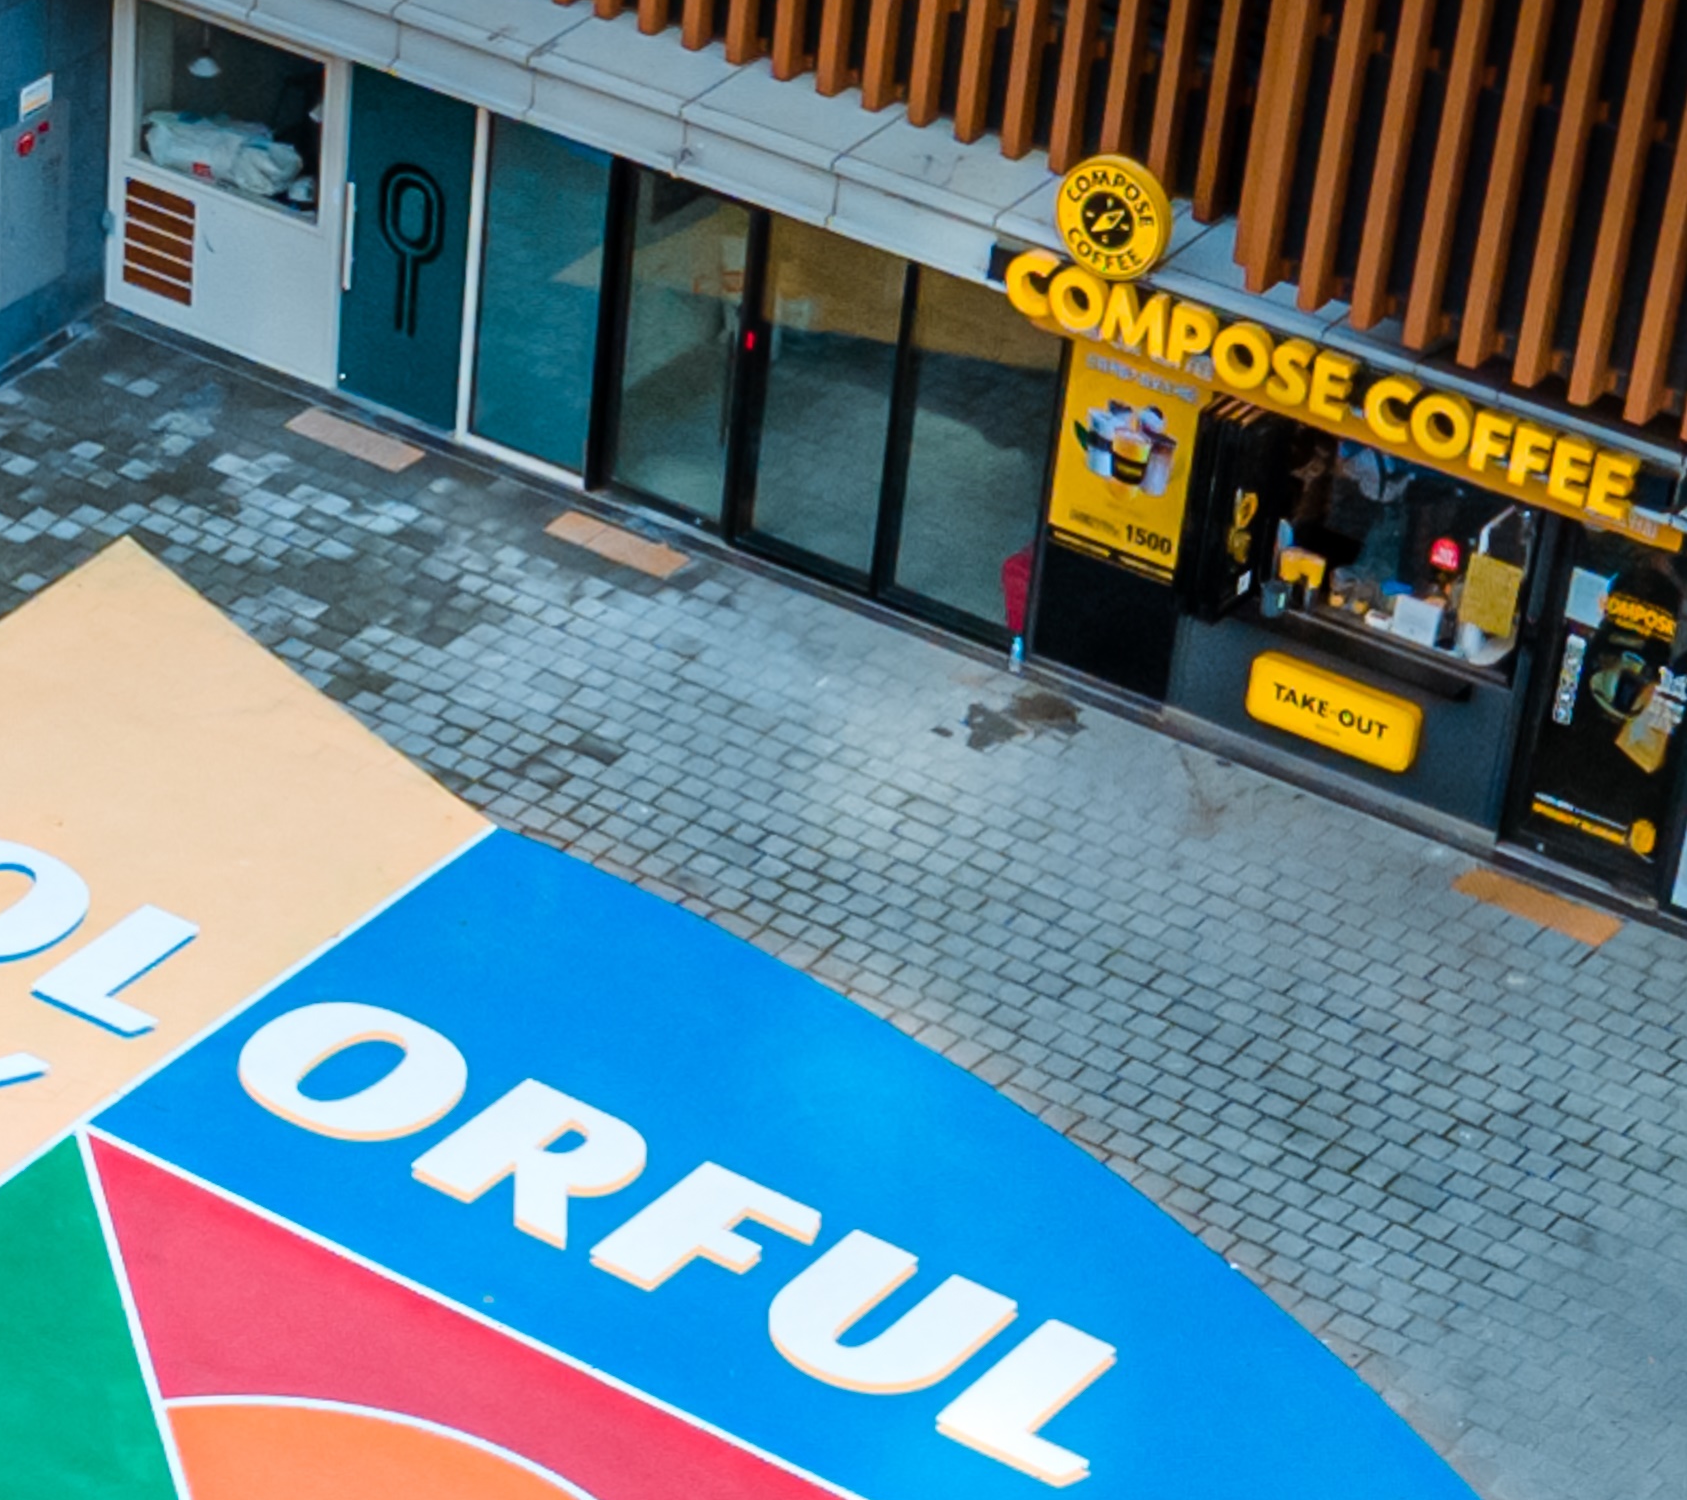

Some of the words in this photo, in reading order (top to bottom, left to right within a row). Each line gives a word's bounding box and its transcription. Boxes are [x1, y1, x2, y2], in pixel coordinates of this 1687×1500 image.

[1067, 170, 1154, 228] COMPOSE
[1068, 227, 1142, 271] COFFEE
[1005, 249, 1358, 422] COMPOSE
[1364, 375, 1642, 523] COFFEE
[1126, 523, 1172, 555] 1500
[237, 1001, 1117, 1486] ORFUL
